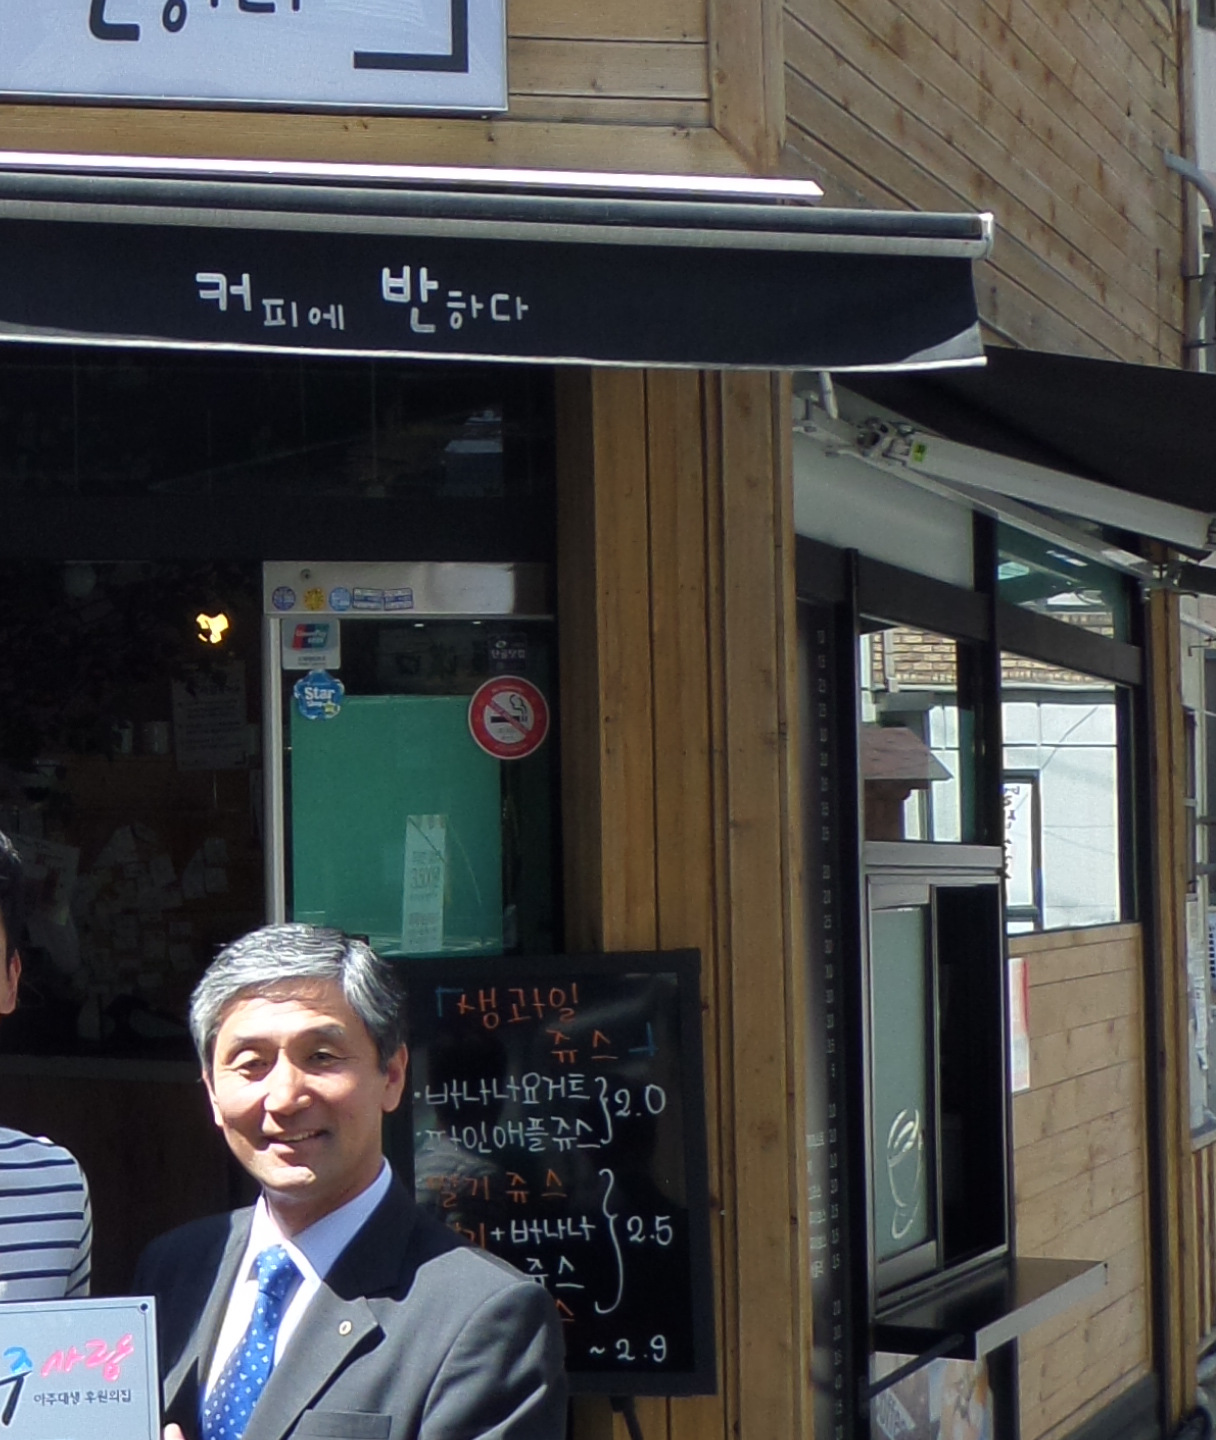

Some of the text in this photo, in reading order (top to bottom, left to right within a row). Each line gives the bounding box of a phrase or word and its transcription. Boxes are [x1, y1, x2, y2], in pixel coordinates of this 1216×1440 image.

[195, 265, 529, 333] 커피에 반하다
[304, 687, 336, 701] Star
[40, 1333, 134, 1383] 사랑
